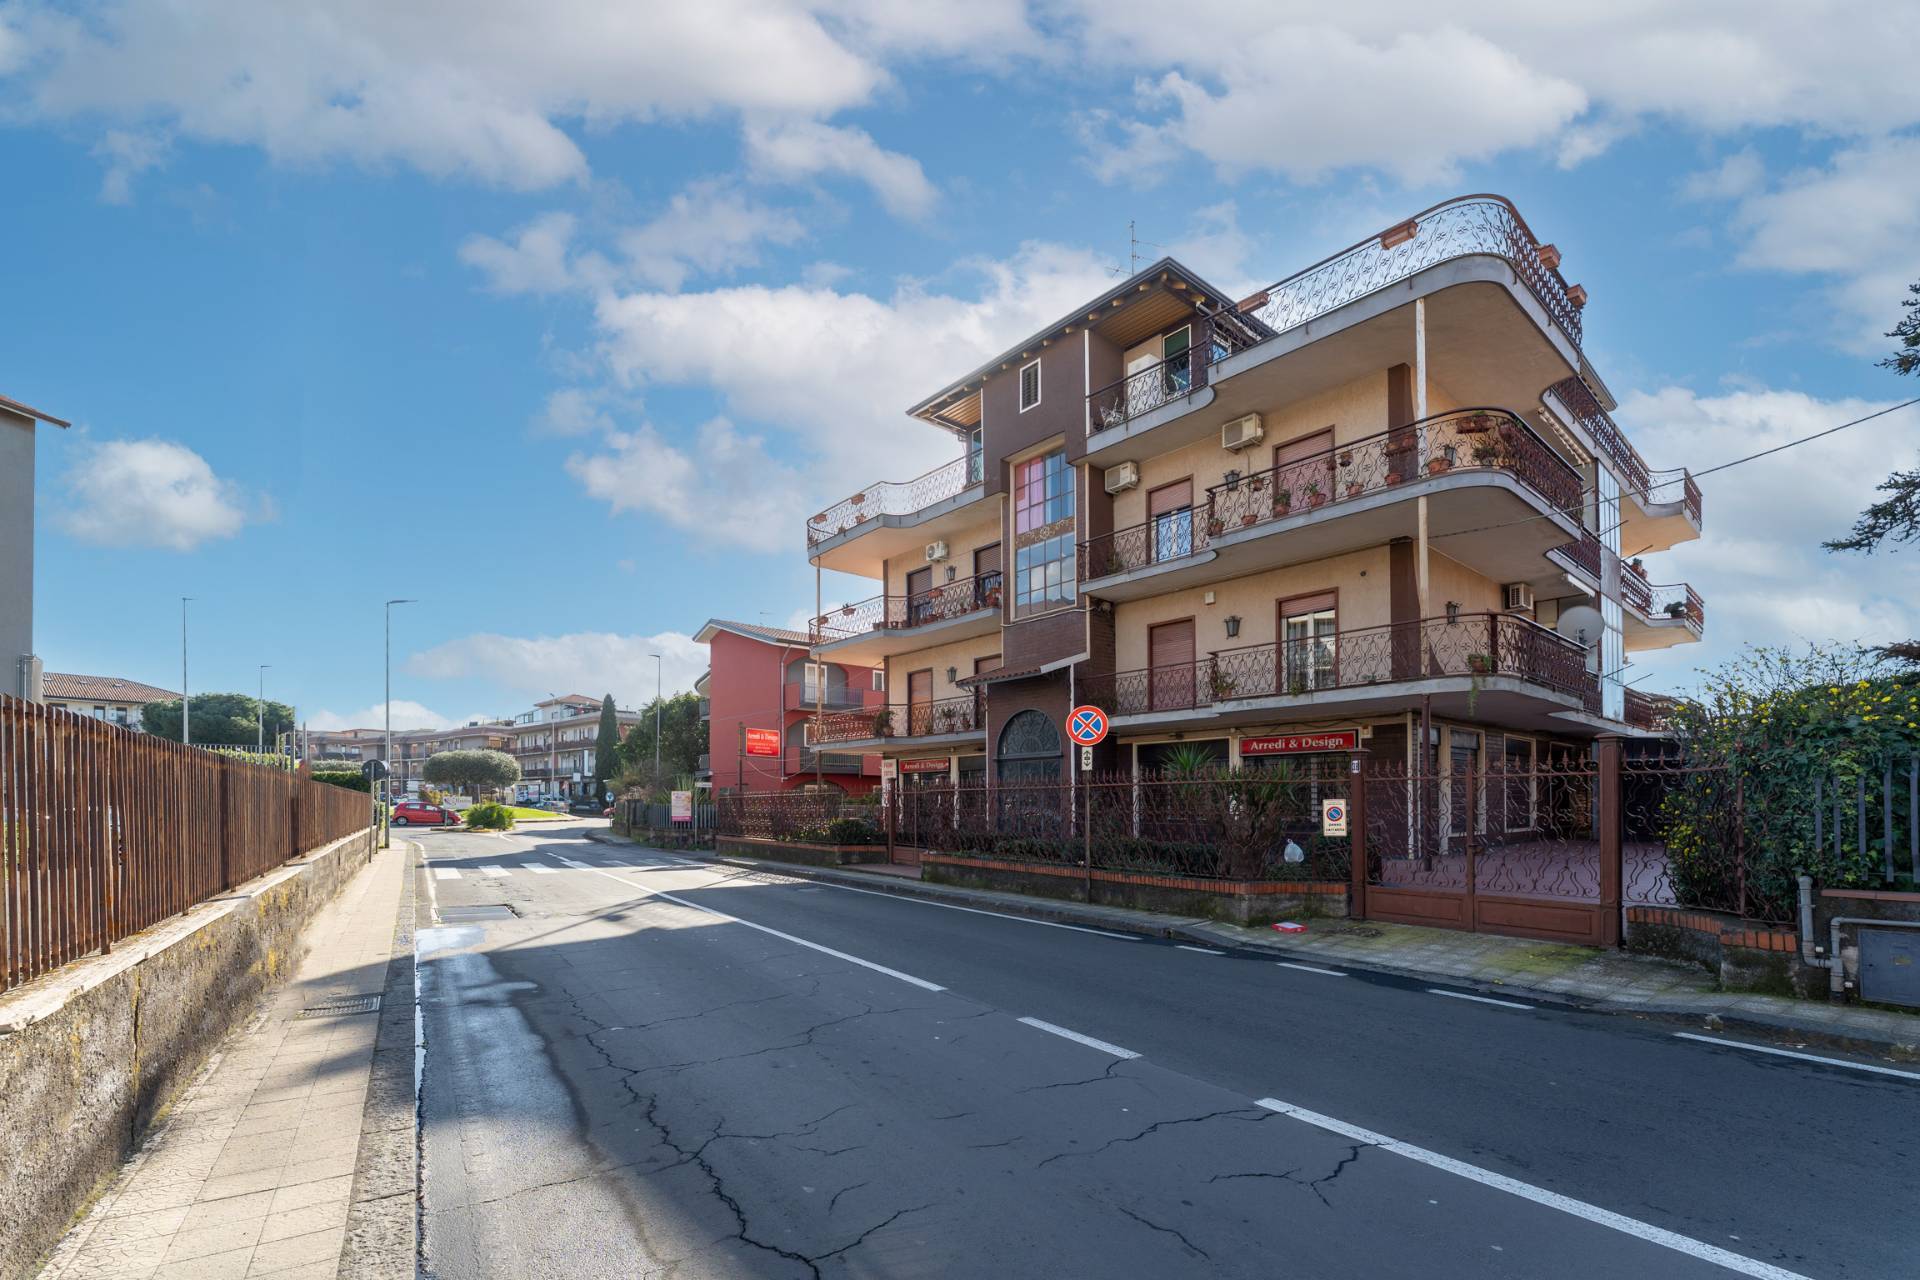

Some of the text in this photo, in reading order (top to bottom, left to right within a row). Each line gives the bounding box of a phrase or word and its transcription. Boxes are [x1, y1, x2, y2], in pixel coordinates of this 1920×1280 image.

[1250, 736, 1344, 751] Arredi & Design
[926, 761, 945, 769] Design
